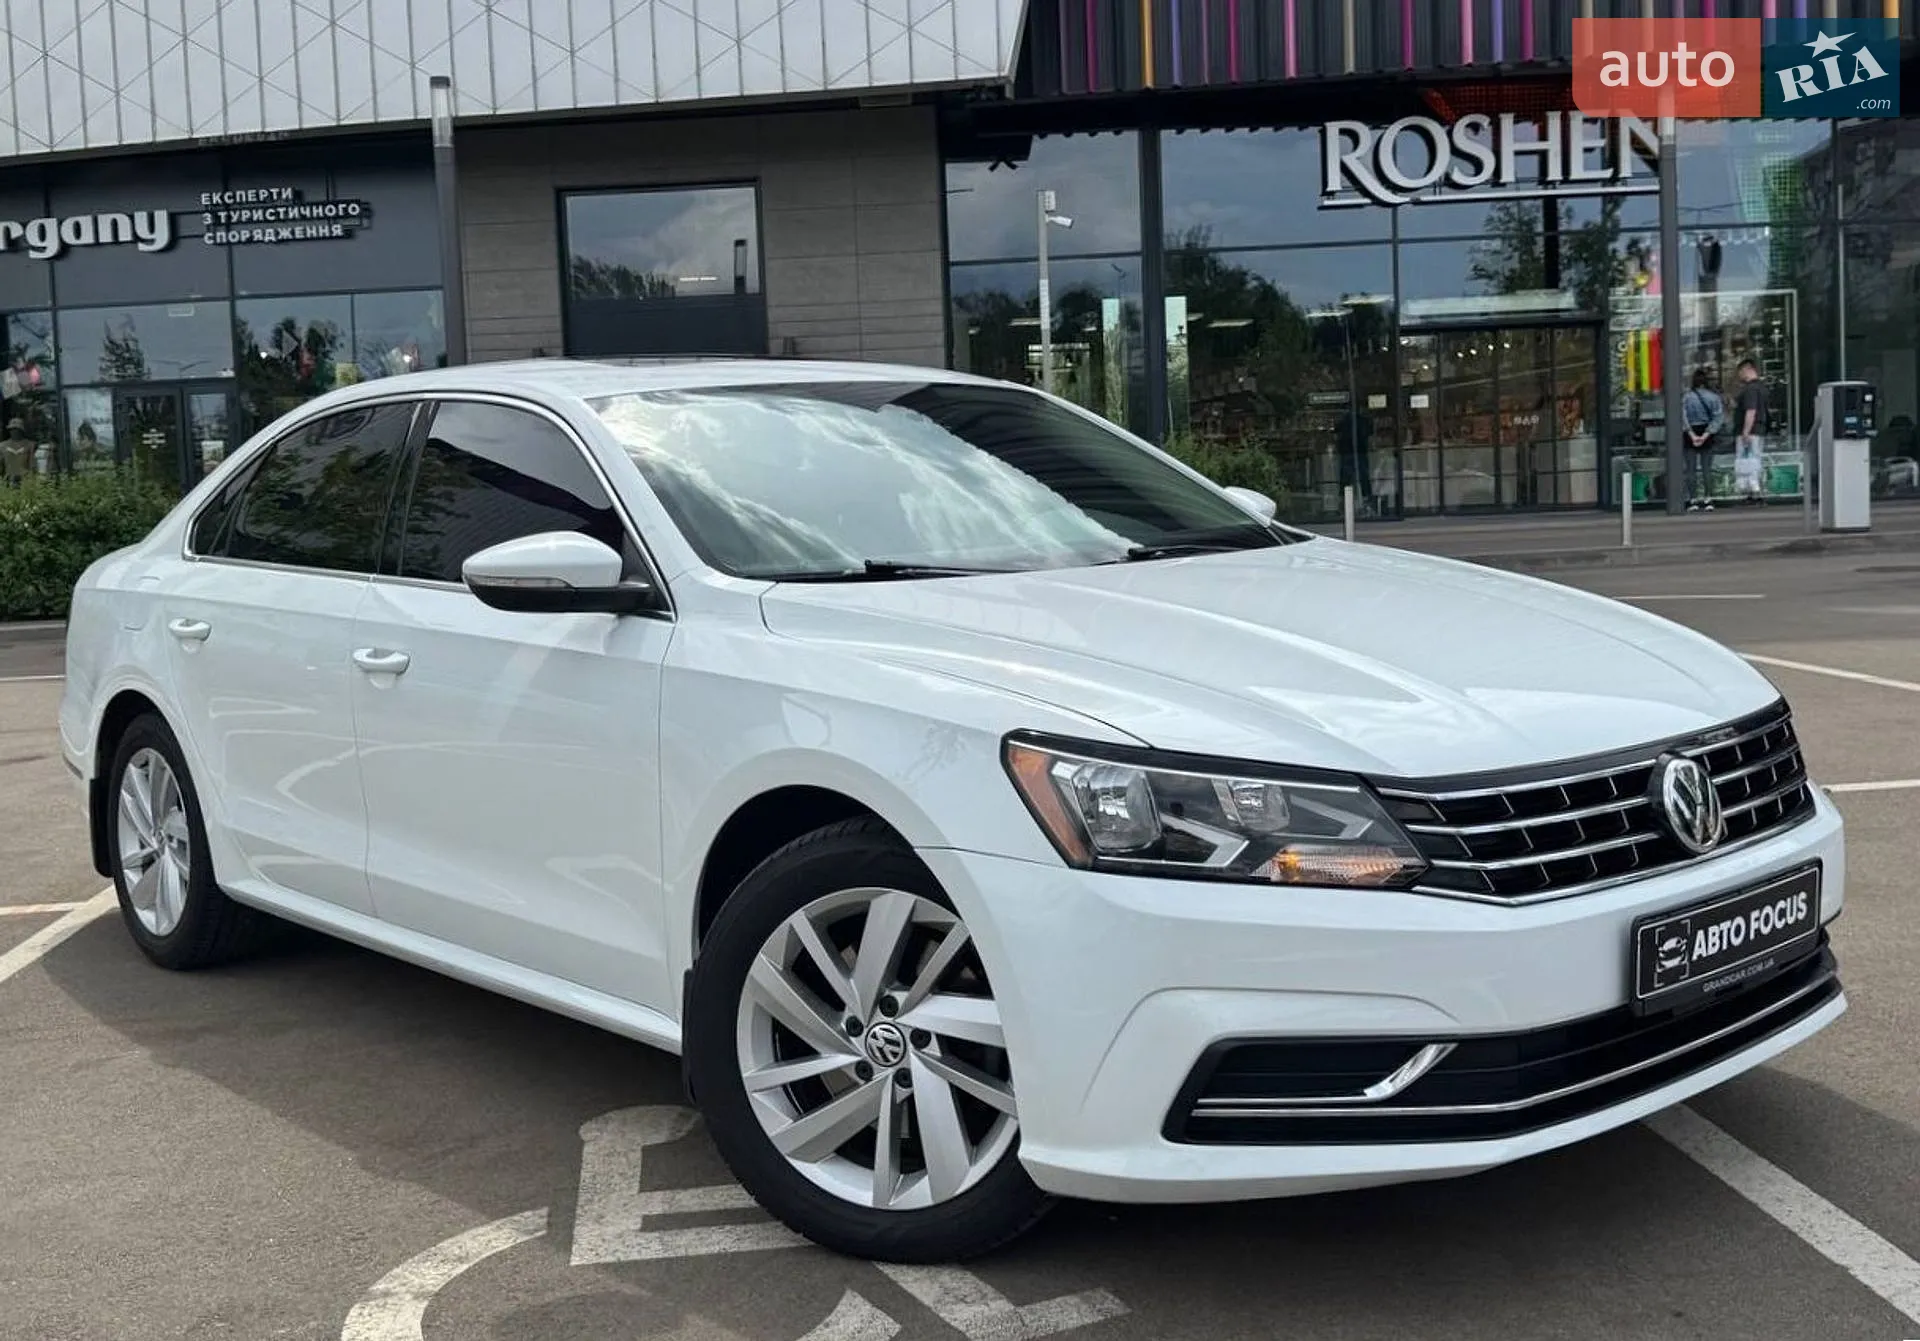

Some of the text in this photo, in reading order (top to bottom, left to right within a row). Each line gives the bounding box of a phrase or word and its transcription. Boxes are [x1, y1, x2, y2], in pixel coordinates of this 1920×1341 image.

[1323, 109, 1660, 204] ROSHEN
[201, 187, 294, 205] ЕКСПЕРТИ
[218, 203, 361, 225] ТУРИСТИЧНОГО
[0, 209, 170, 259] rgany
[203, 224, 344, 245] СПОРЯДЖЕННЯ
[1691, 891, 1808, 961] АВТО FOCUS
